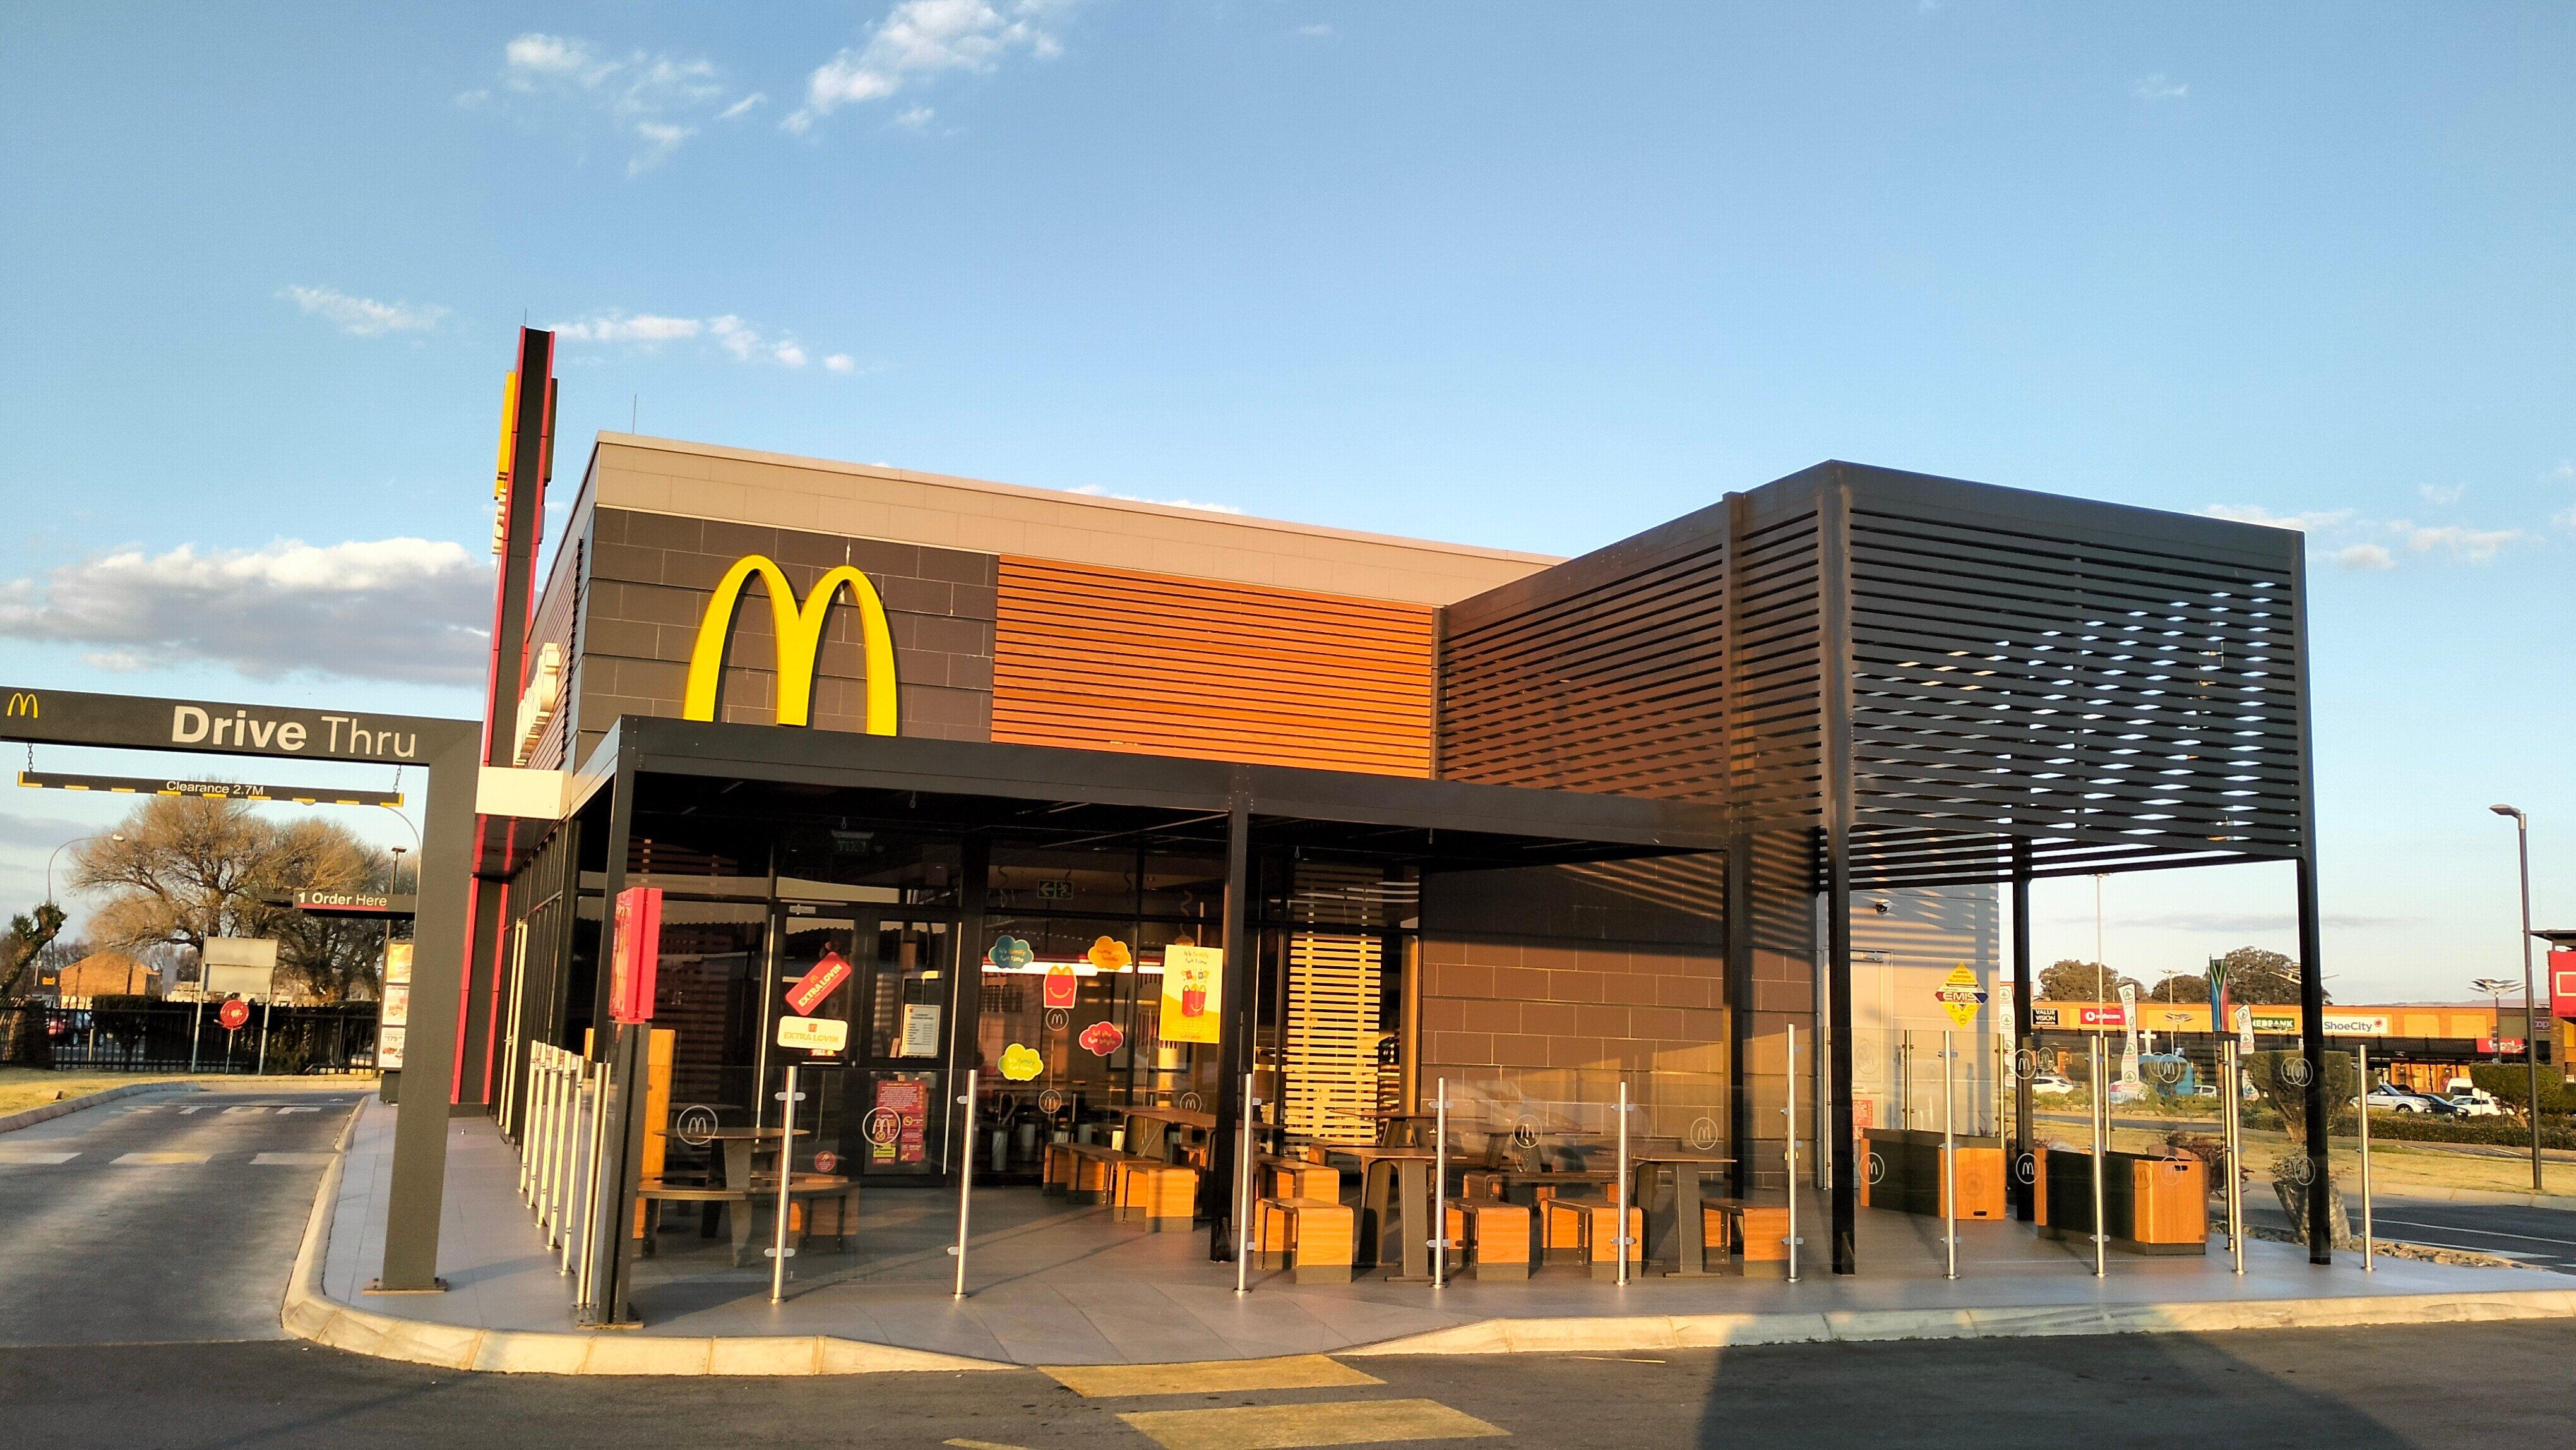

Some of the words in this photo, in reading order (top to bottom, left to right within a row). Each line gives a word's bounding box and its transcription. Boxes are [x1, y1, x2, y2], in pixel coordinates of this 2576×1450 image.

[171, 705, 307, 751] Drive
[321, 716, 416, 758] Thru
[166, 780, 230, 795] Clearance
[233, 784, 264, 796] 2.7M
[298, 892, 306, 904] 1
[311, 892, 352, 906] Order
[355, 894, 388, 907] Here
[797, 983, 823, 1007] EXTRA
[820, 963, 843, 988] LOVIN
[1943, 992, 1976, 1001] EMIS
[2324, 1021, 2373, 1032] ShoeCity
[784, 1032, 811, 1041] EXTRA
[109, 1105, 322, 1115] STOP
